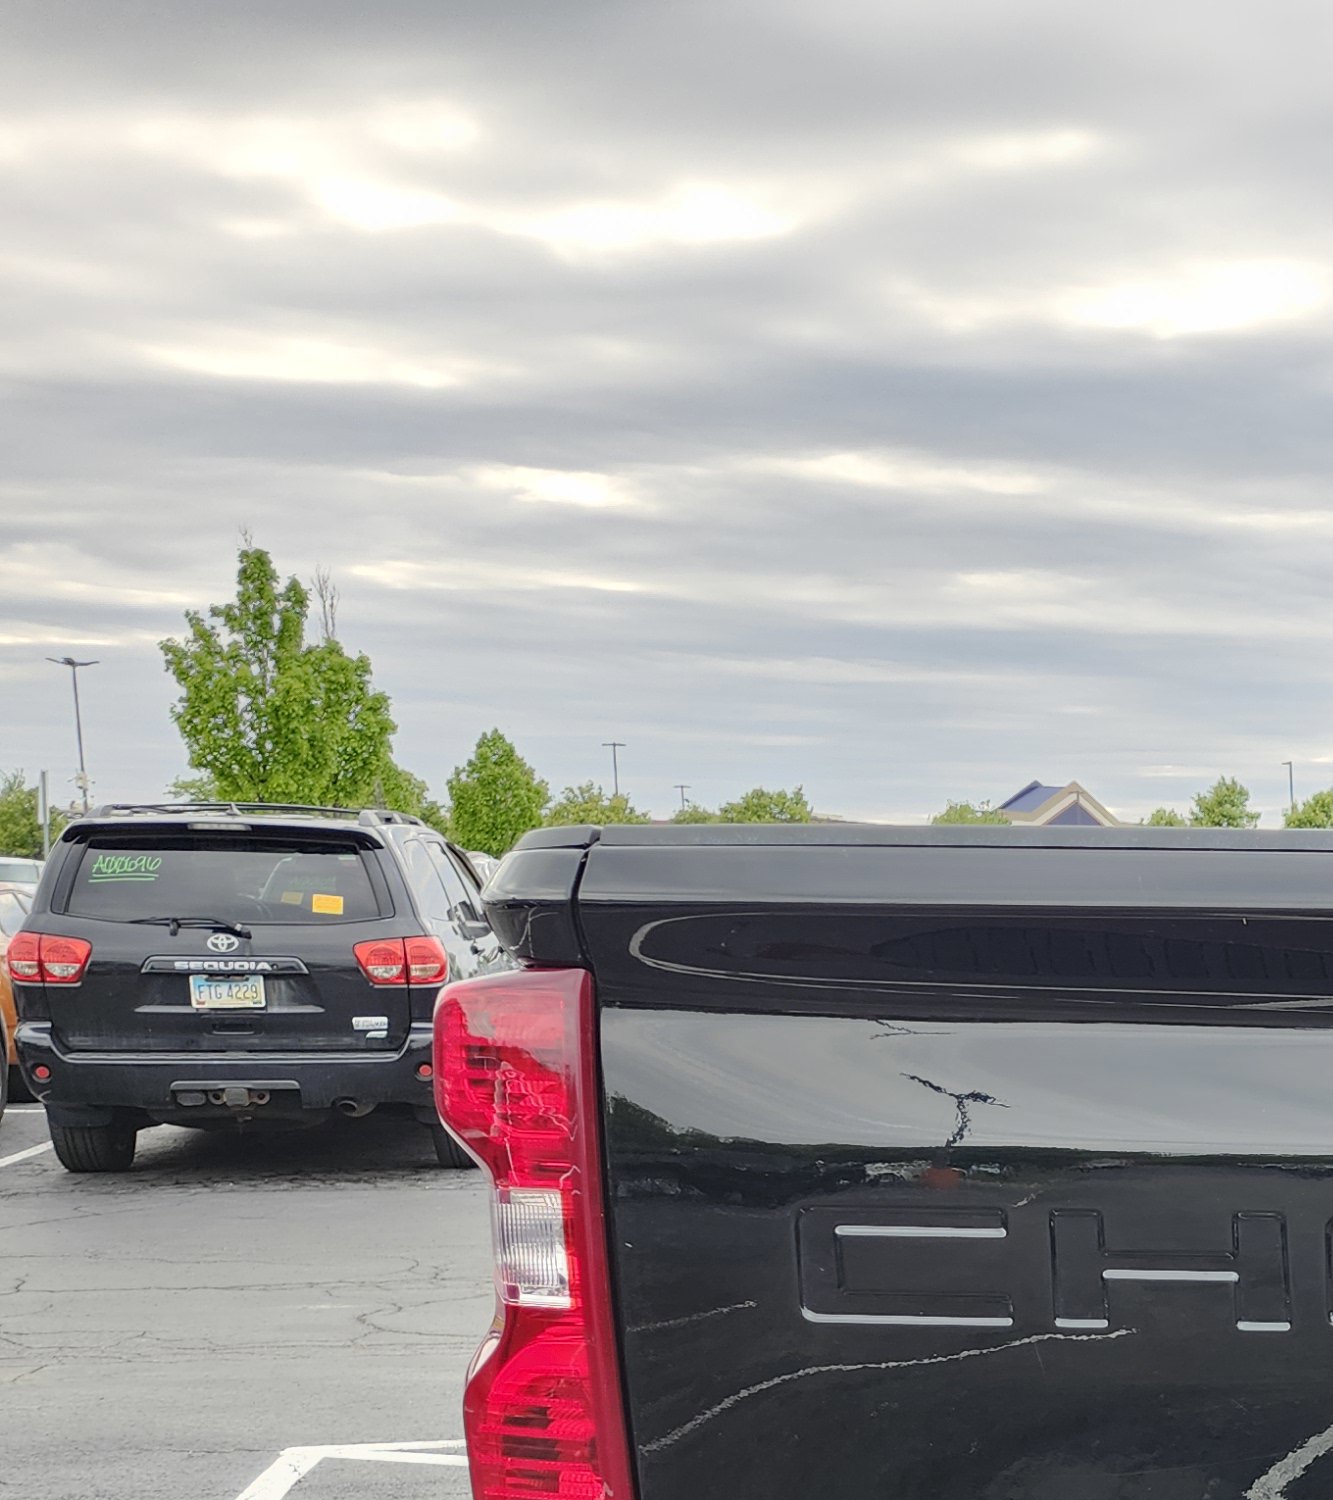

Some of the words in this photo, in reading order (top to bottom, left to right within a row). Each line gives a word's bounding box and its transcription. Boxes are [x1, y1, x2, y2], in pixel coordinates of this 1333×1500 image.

[174, 961, 272, 971] SEQUOIA
[197, 984, 222, 999] FTG
[227, 984, 258, 1000] 4229
